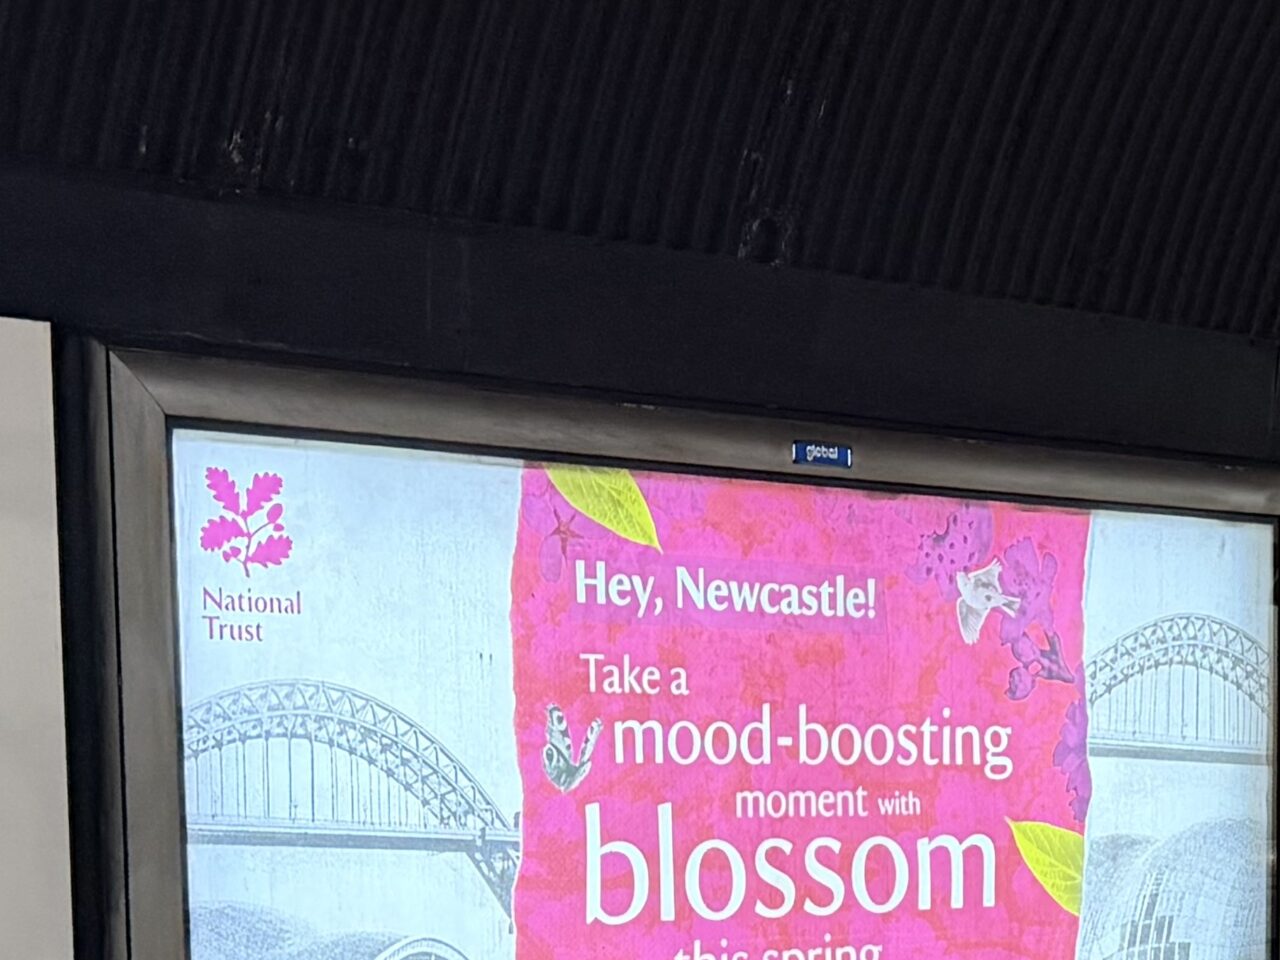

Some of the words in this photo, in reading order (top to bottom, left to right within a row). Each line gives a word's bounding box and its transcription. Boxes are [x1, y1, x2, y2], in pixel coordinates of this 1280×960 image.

[806, 444, 838, 461] global
[203, 587, 302, 614] National
[575, 560, 663, 618] Hey,
[676, 566, 876, 618] Newcastle!
[201, 616, 264, 641] Trust
[580, 653, 661, 695] Take
[671, 665, 689, 695] a
[614, 703, 1013, 780] mood-boosting
[735, 786, 867, 818] moment
[878, 790, 921, 816] with
[585, 802, 996, 926] blossom
